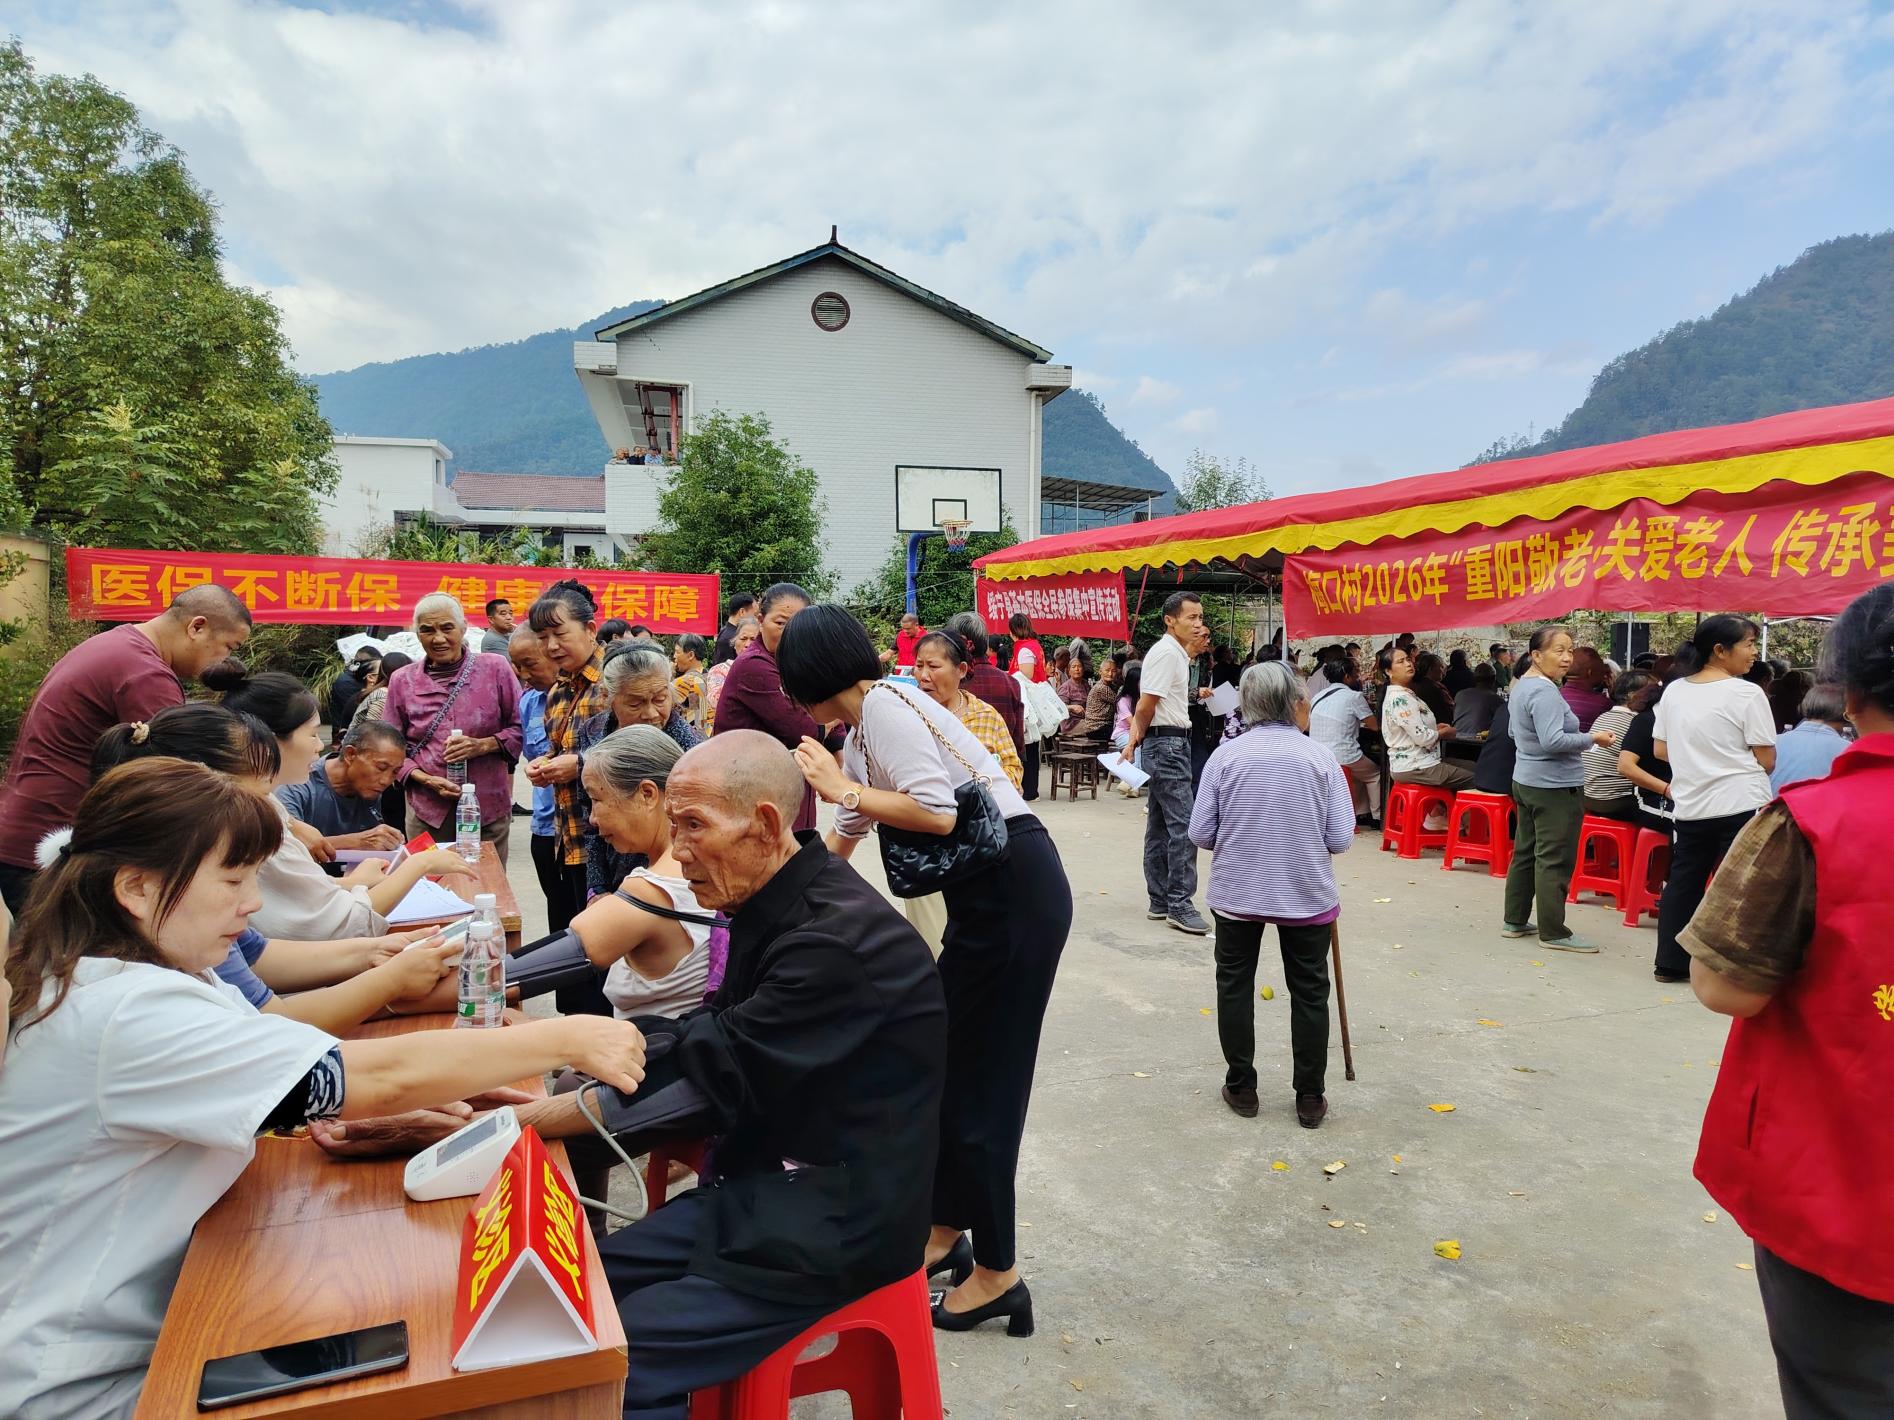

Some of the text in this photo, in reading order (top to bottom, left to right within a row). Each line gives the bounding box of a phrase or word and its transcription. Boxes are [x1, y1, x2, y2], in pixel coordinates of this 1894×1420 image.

[436, 575, 700, 623] 健康保障
[470, 1168, 514, 1312] 义诊区
[543, 1160, 584, 1301] 义诊区
